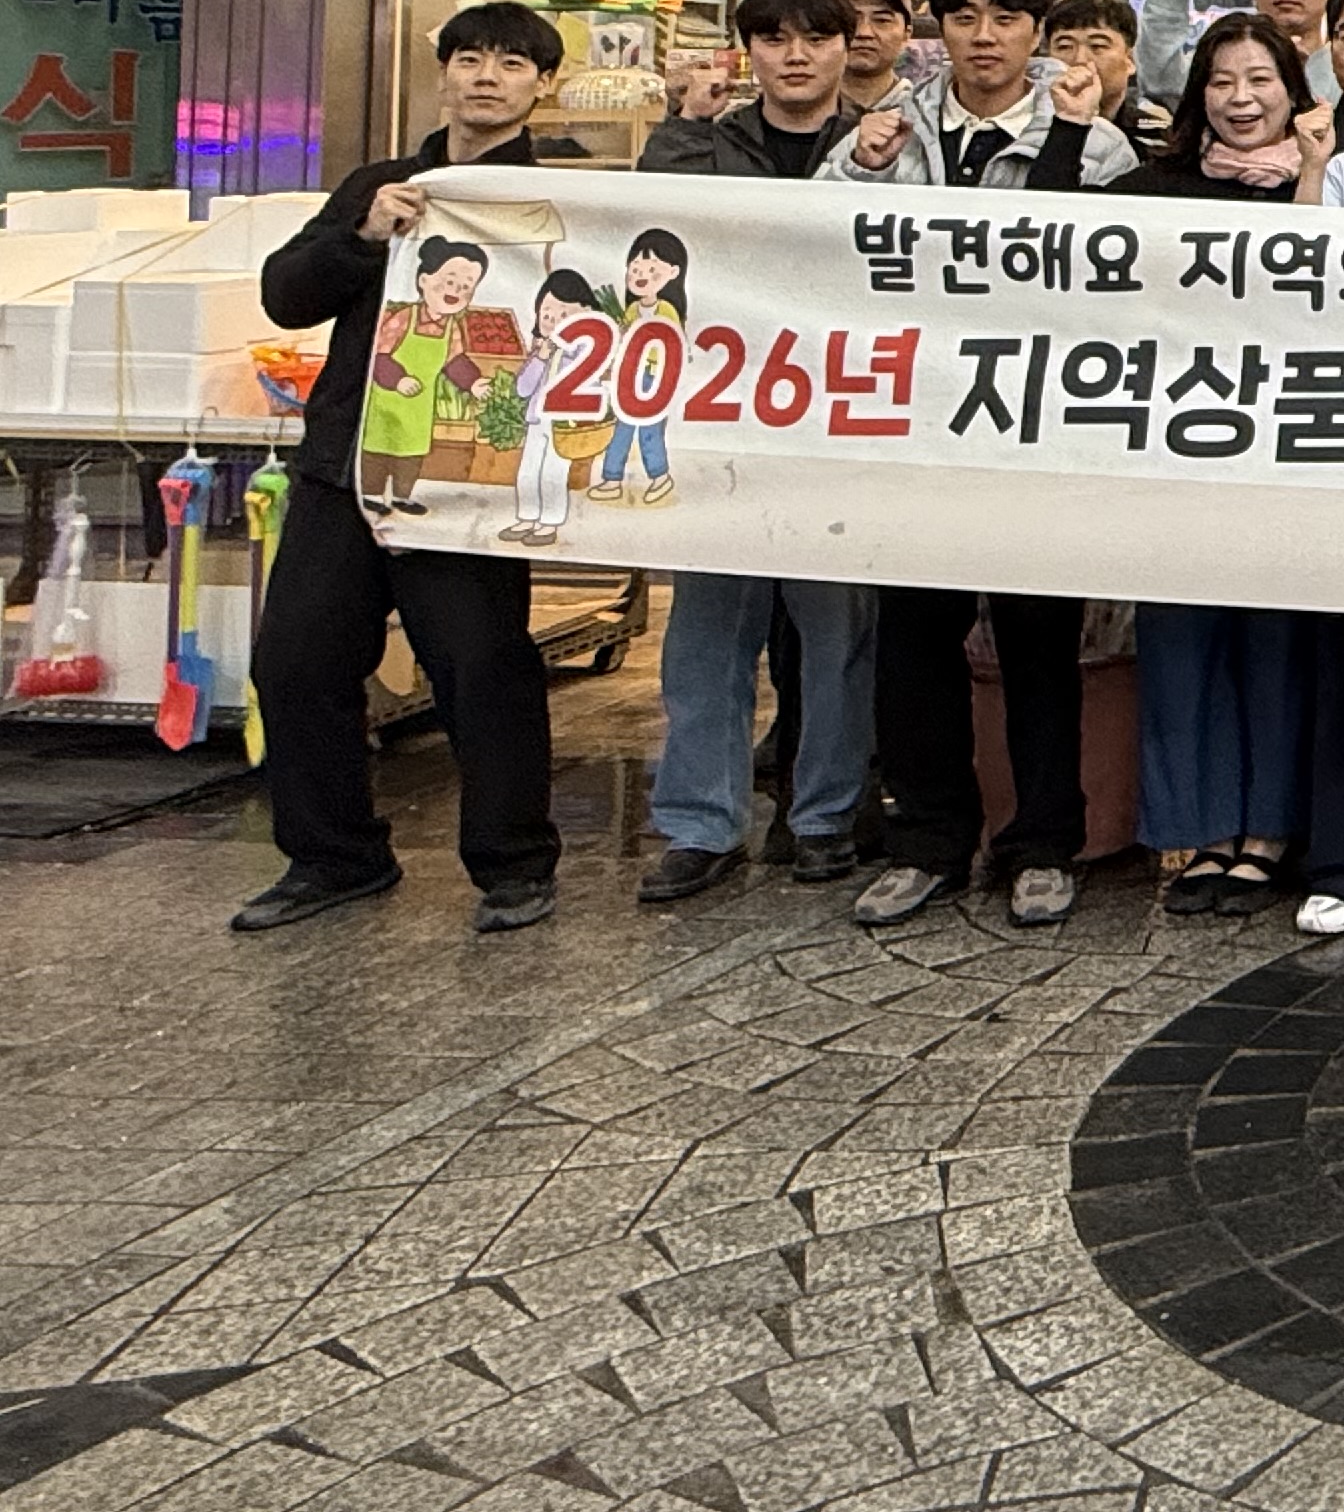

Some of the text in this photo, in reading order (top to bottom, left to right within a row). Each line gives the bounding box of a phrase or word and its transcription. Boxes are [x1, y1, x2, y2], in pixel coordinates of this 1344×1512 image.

[1, 50, 140, 178] 식
[854, 213, 1143, 294] 발견해요
[543, 317, 921, 437] 2026년
